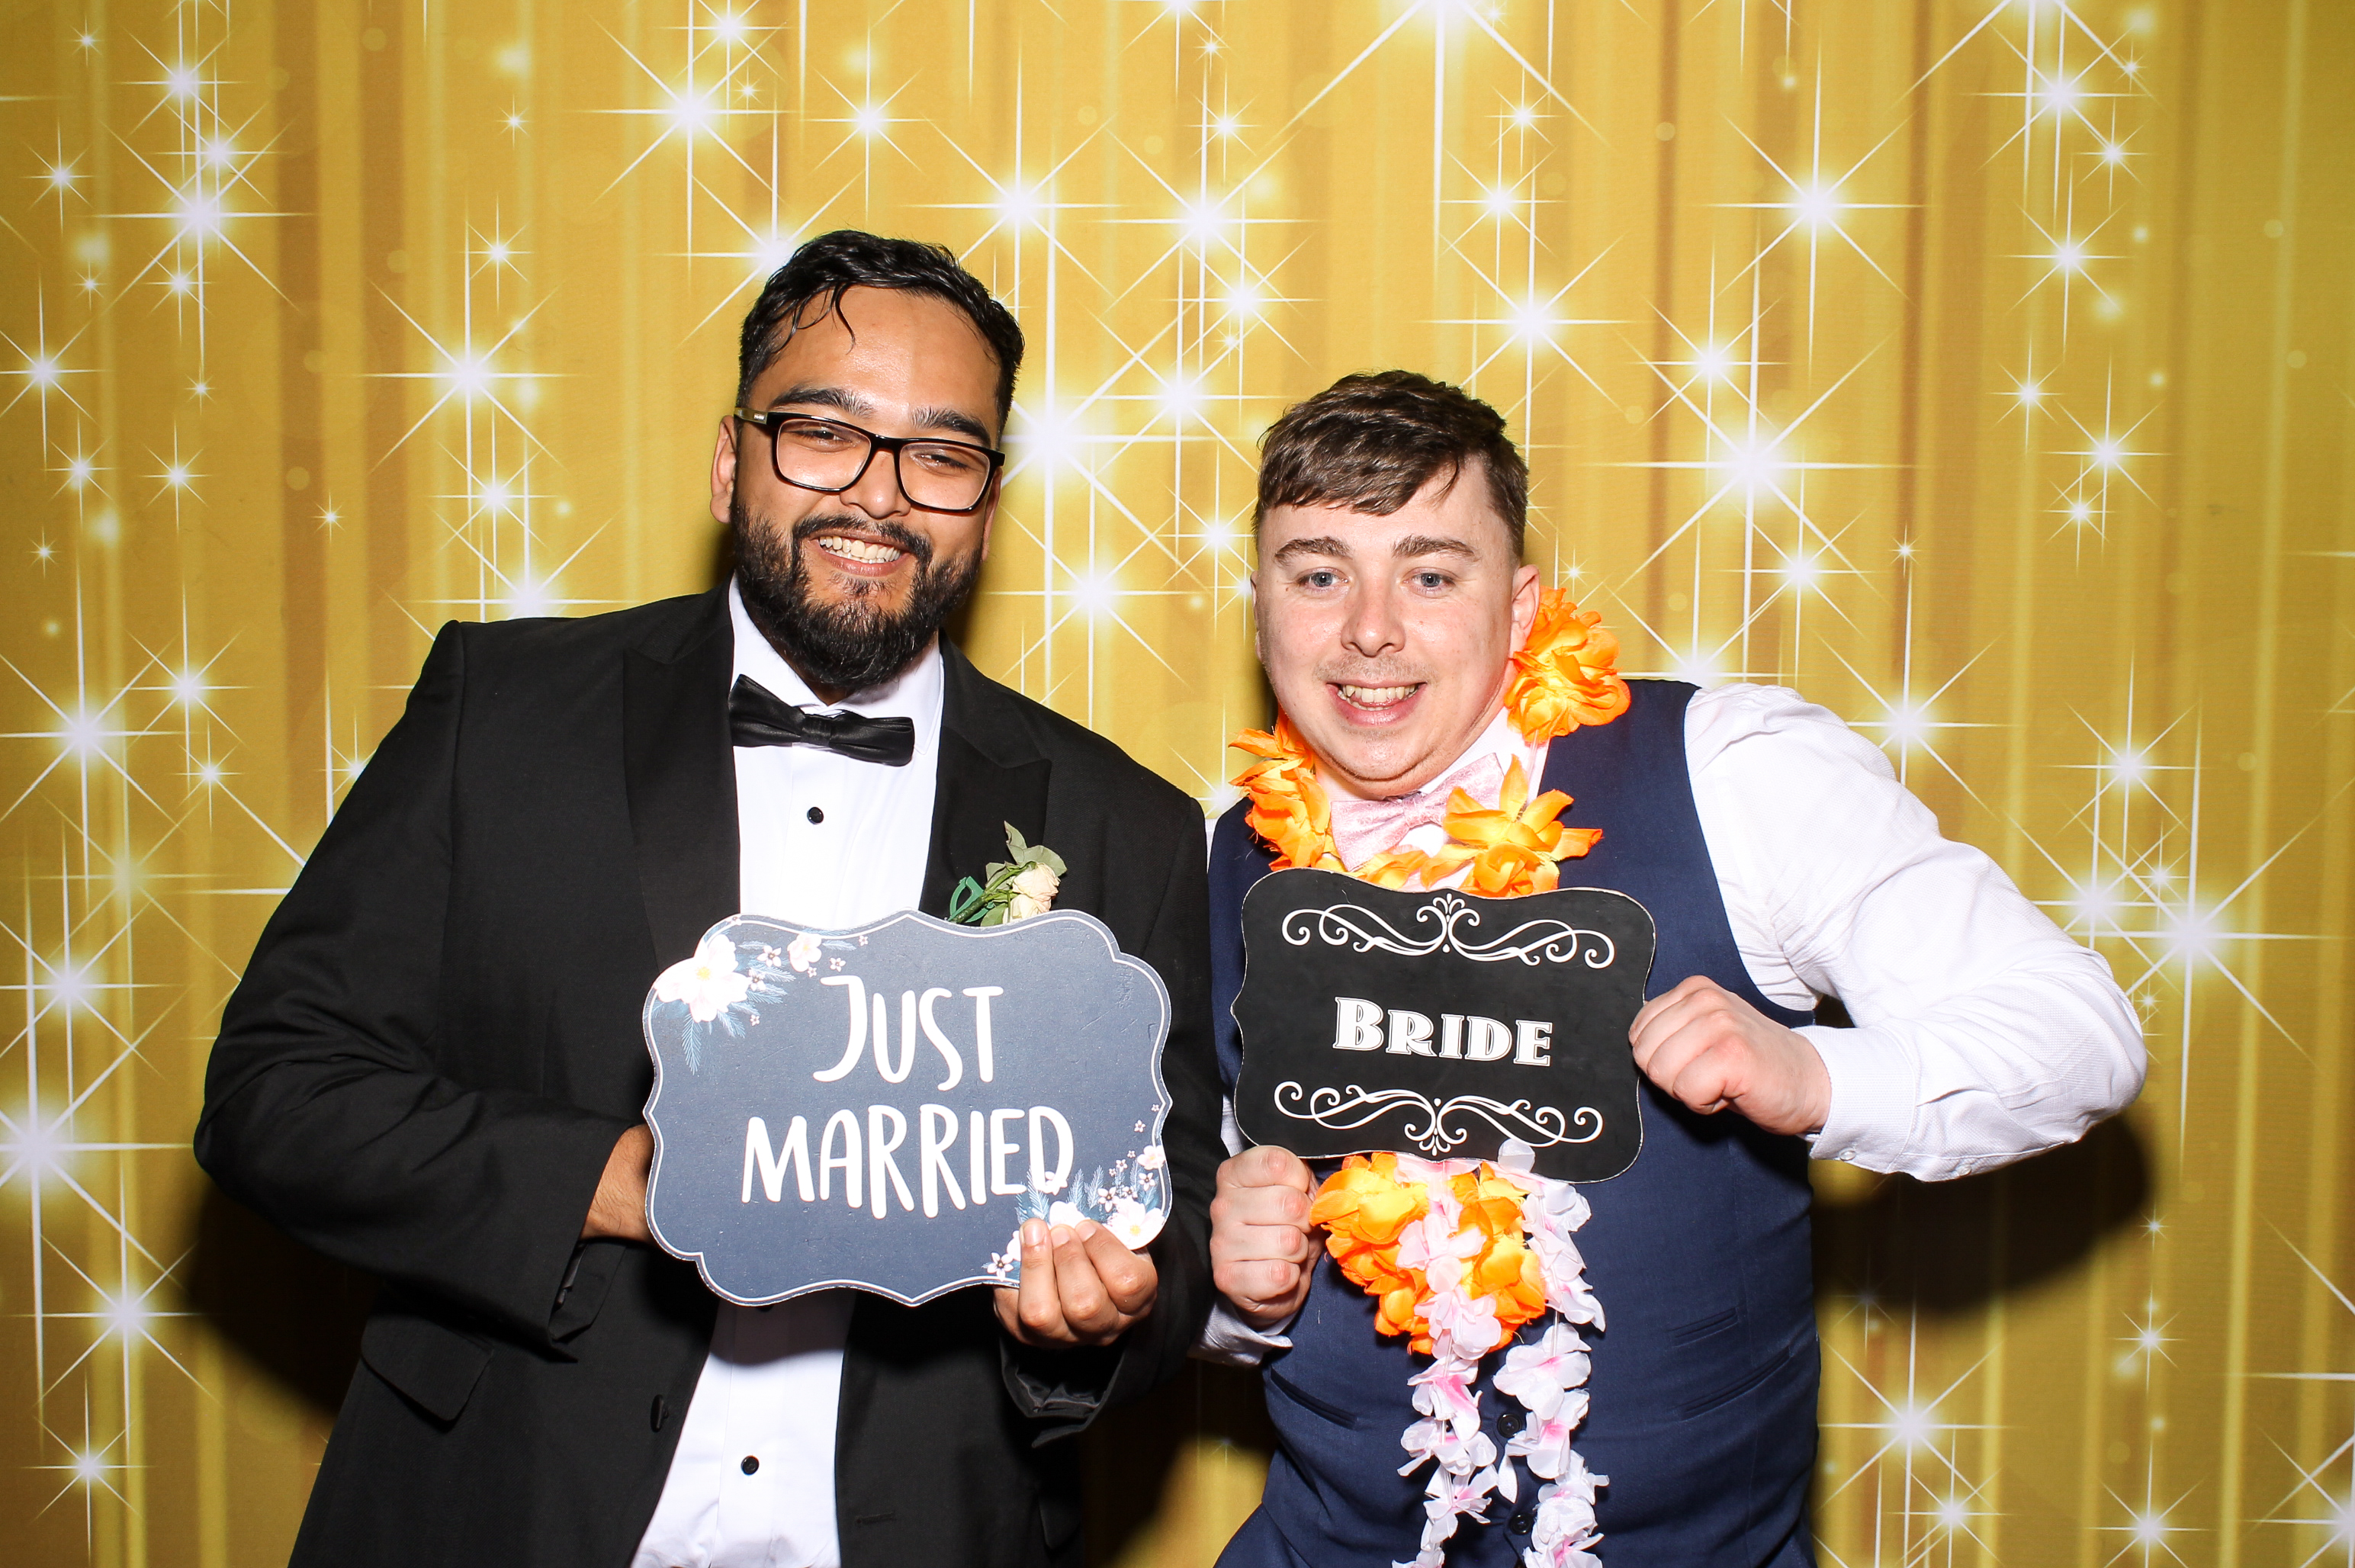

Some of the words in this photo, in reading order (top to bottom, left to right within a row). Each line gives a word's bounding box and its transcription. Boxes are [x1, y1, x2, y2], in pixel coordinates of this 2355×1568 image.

[813, 975, 1004, 1091] JUST
[1332, 996, 1553, 1067] BRIDE
[741, 1103, 1075, 1219] MARRIED
